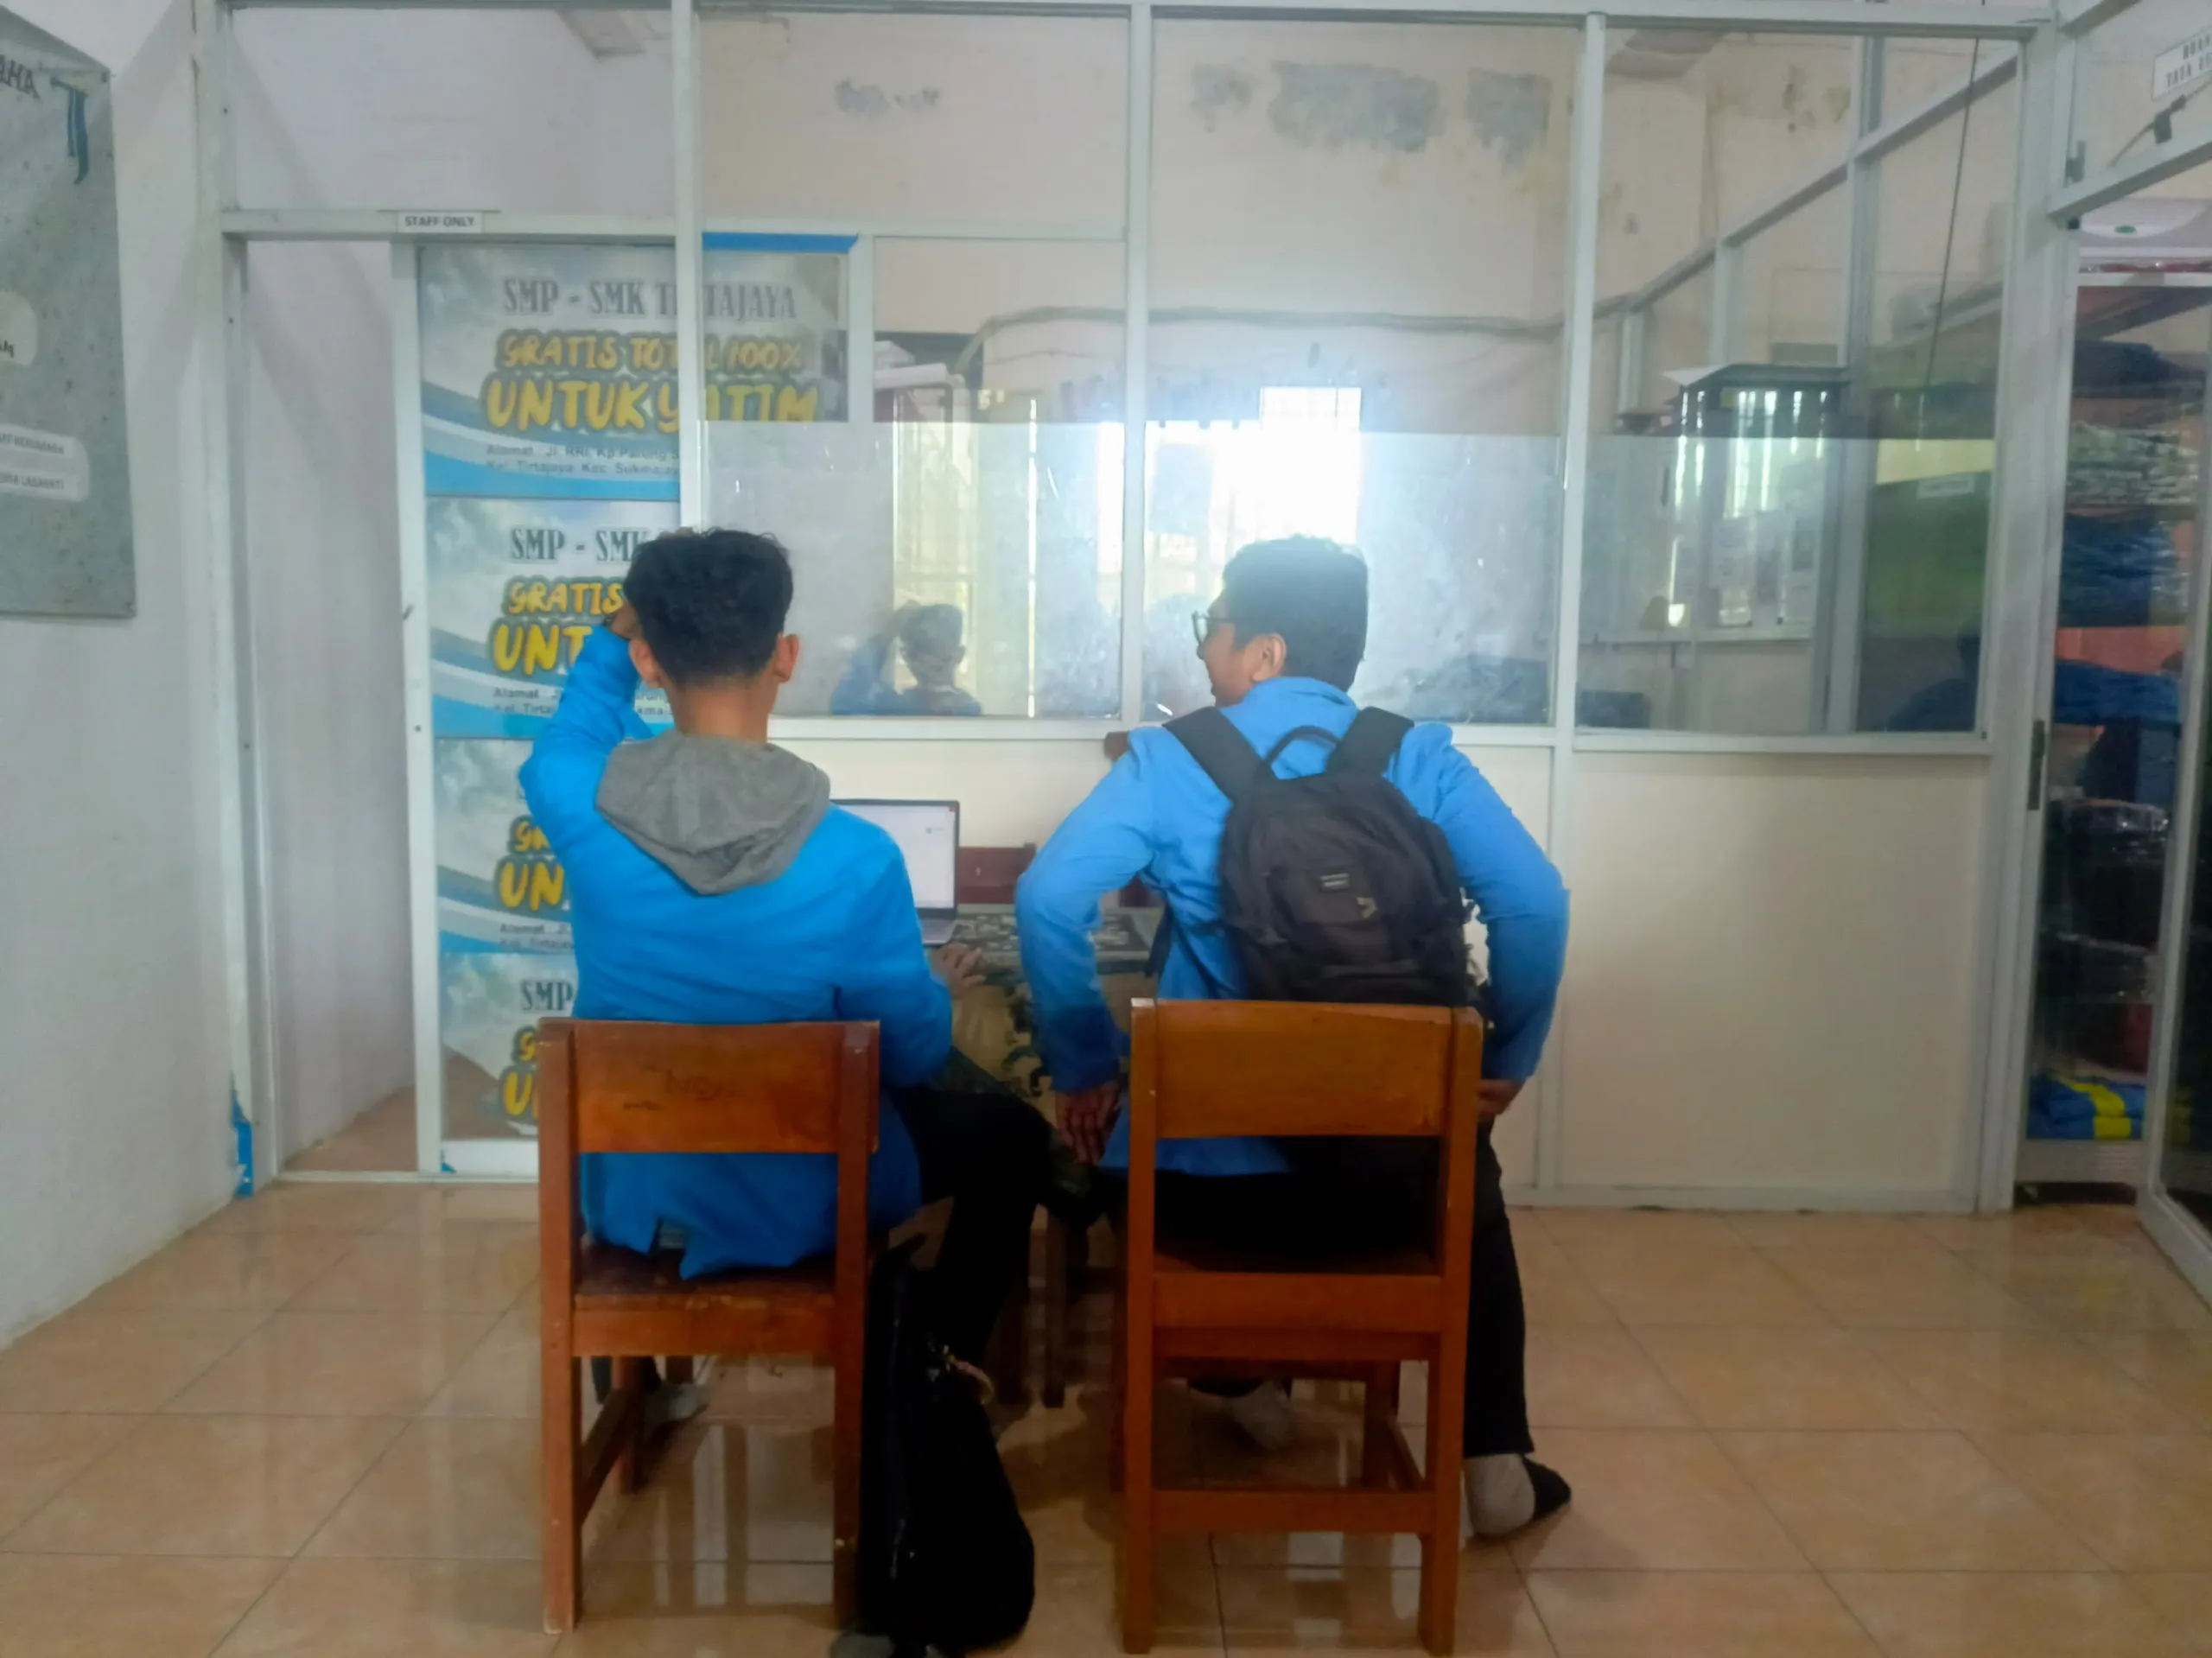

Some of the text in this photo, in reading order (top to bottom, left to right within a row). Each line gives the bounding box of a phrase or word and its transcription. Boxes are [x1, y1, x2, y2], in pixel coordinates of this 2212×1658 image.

[404, 215, 475, 228] STAFF ONLY
[502, 278, 558, 314] SMP
[588, 279, 645, 315] SMK
[653, 281, 798, 321] TITAJAYA
[502, 333, 804, 371] GRATIS TOTL 100%
[486, 378, 650, 433] UNTUK
[511, 528, 566, 561] SMP
[507, 580, 624, 616] GRATIS
[493, 623, 594, 676] UNT
[493, 687, 539, 699] Alamat
[499, 861, 565, 912] UN
[520, 980, 574, 1012] SMP
